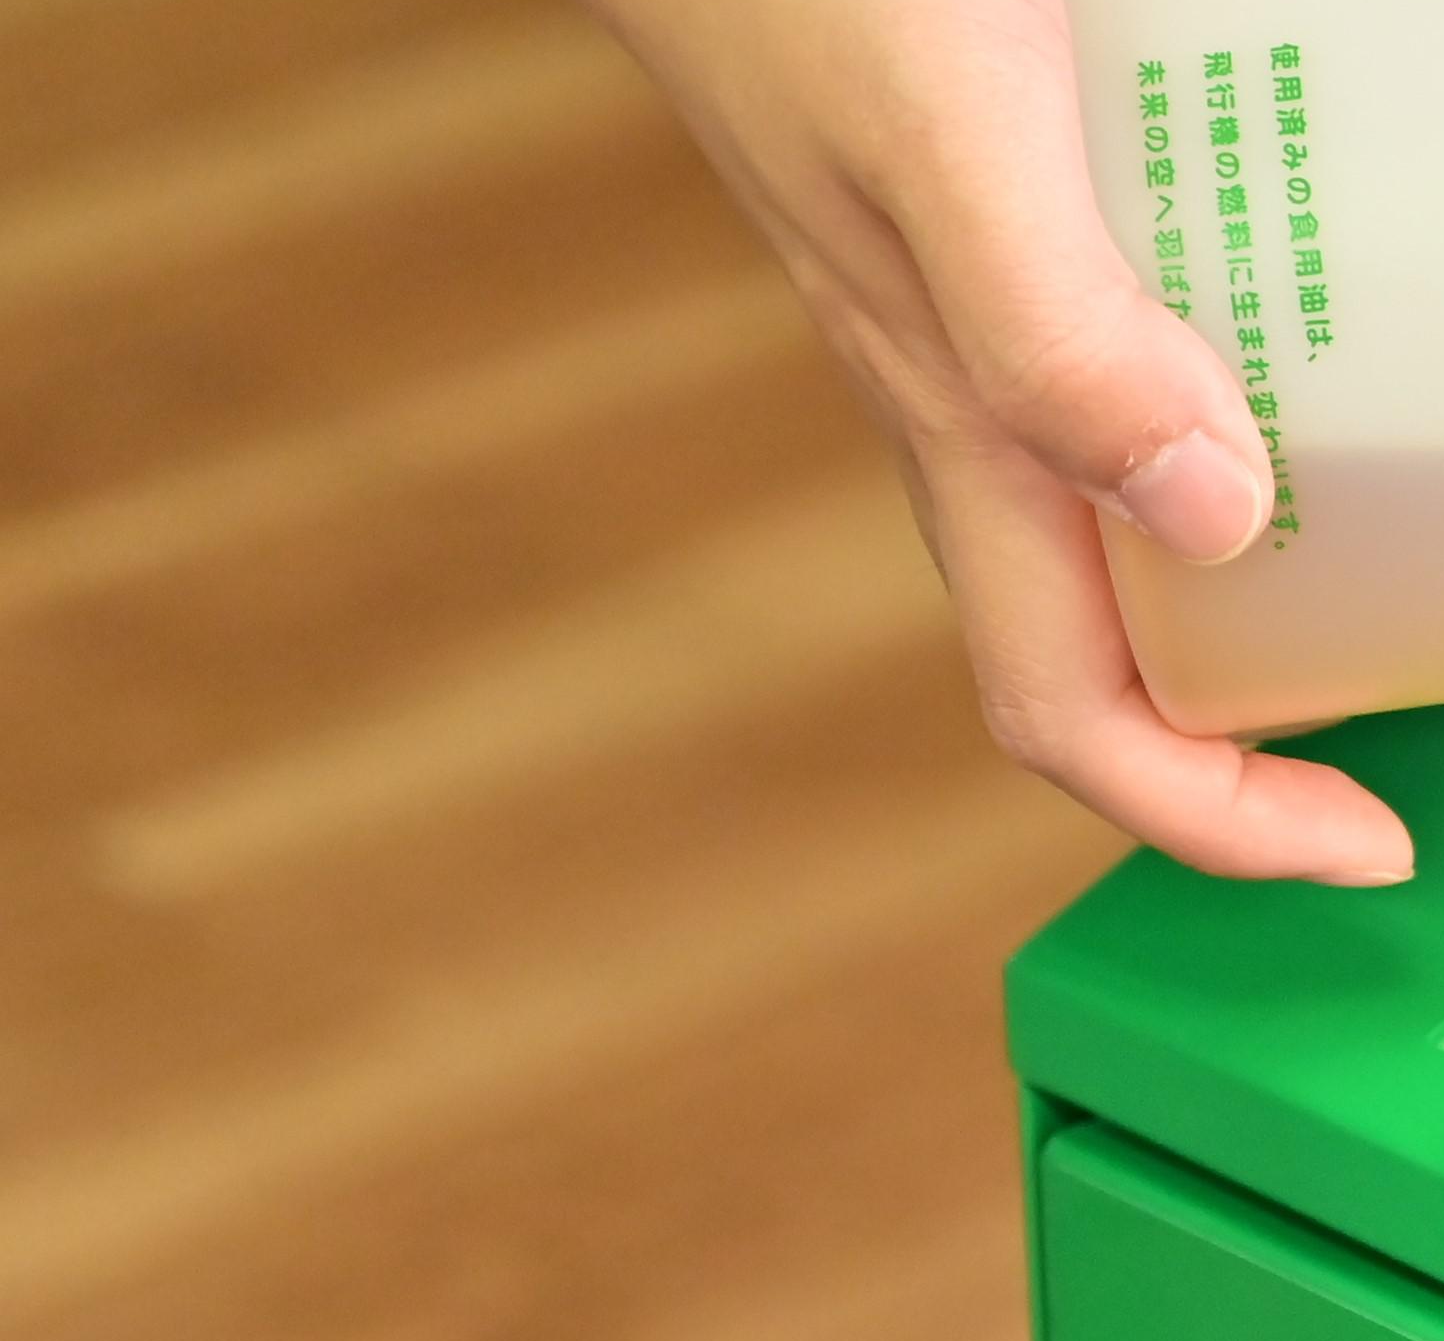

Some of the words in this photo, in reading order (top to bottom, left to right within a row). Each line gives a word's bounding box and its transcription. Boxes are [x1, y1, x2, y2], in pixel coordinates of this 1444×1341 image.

[1269, 42, 1334, 363] 使用済みの食用油は、
